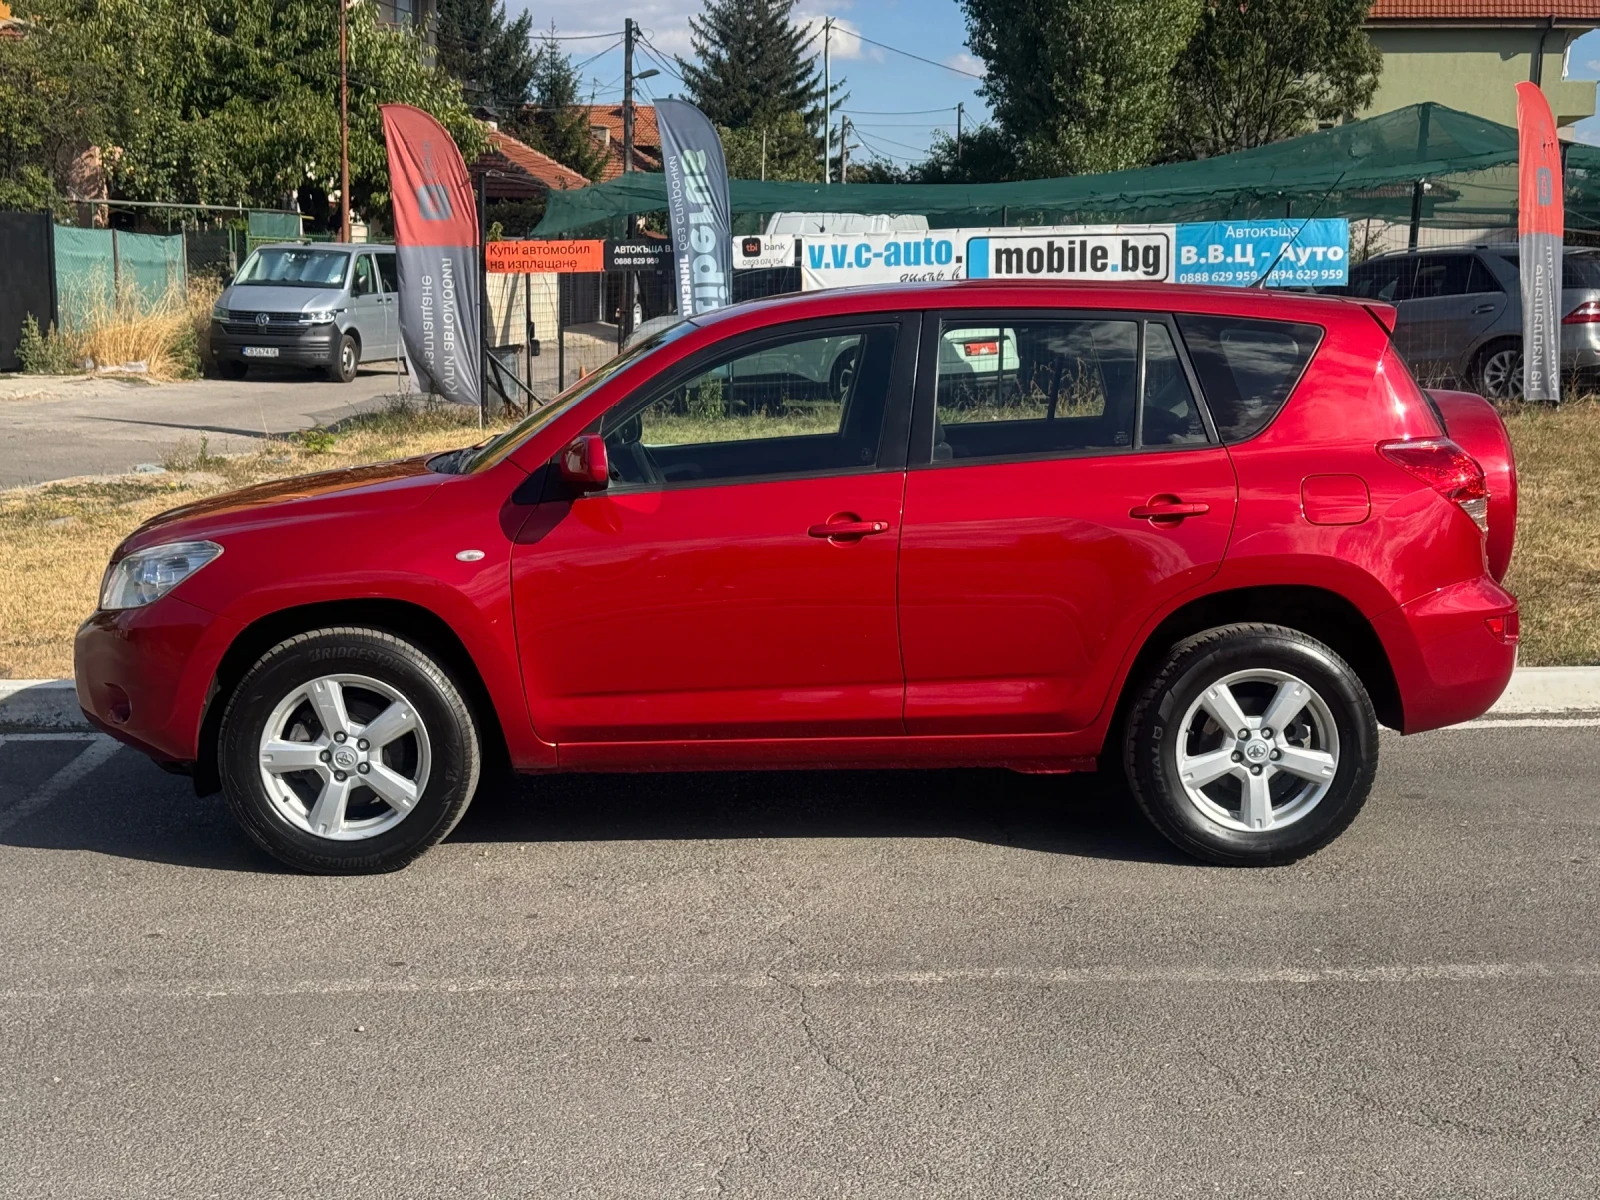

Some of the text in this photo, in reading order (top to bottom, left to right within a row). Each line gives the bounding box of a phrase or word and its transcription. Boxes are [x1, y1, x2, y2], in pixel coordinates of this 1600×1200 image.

[1225, 225, 1299, 239] Автокъща
[490, 243, 590, 258] Купи автомобил
[746, 242, 785, 252] tbi bank
[633, 257, 645, 265] 629
[995, 239, 1161, 276] mobile.bg
[1181, 243, 1255, 267] В.В.Ц
[1280, 242, 1344, 267] Ауто
[490, 259, 577, 271] на изплащане
[1179, 272, 1209, 283] 0888
[1211, 271, 1233, 282] 629
[1296, 269, 1319, 280] 629
[1321, 269, 1343, 280] 959
